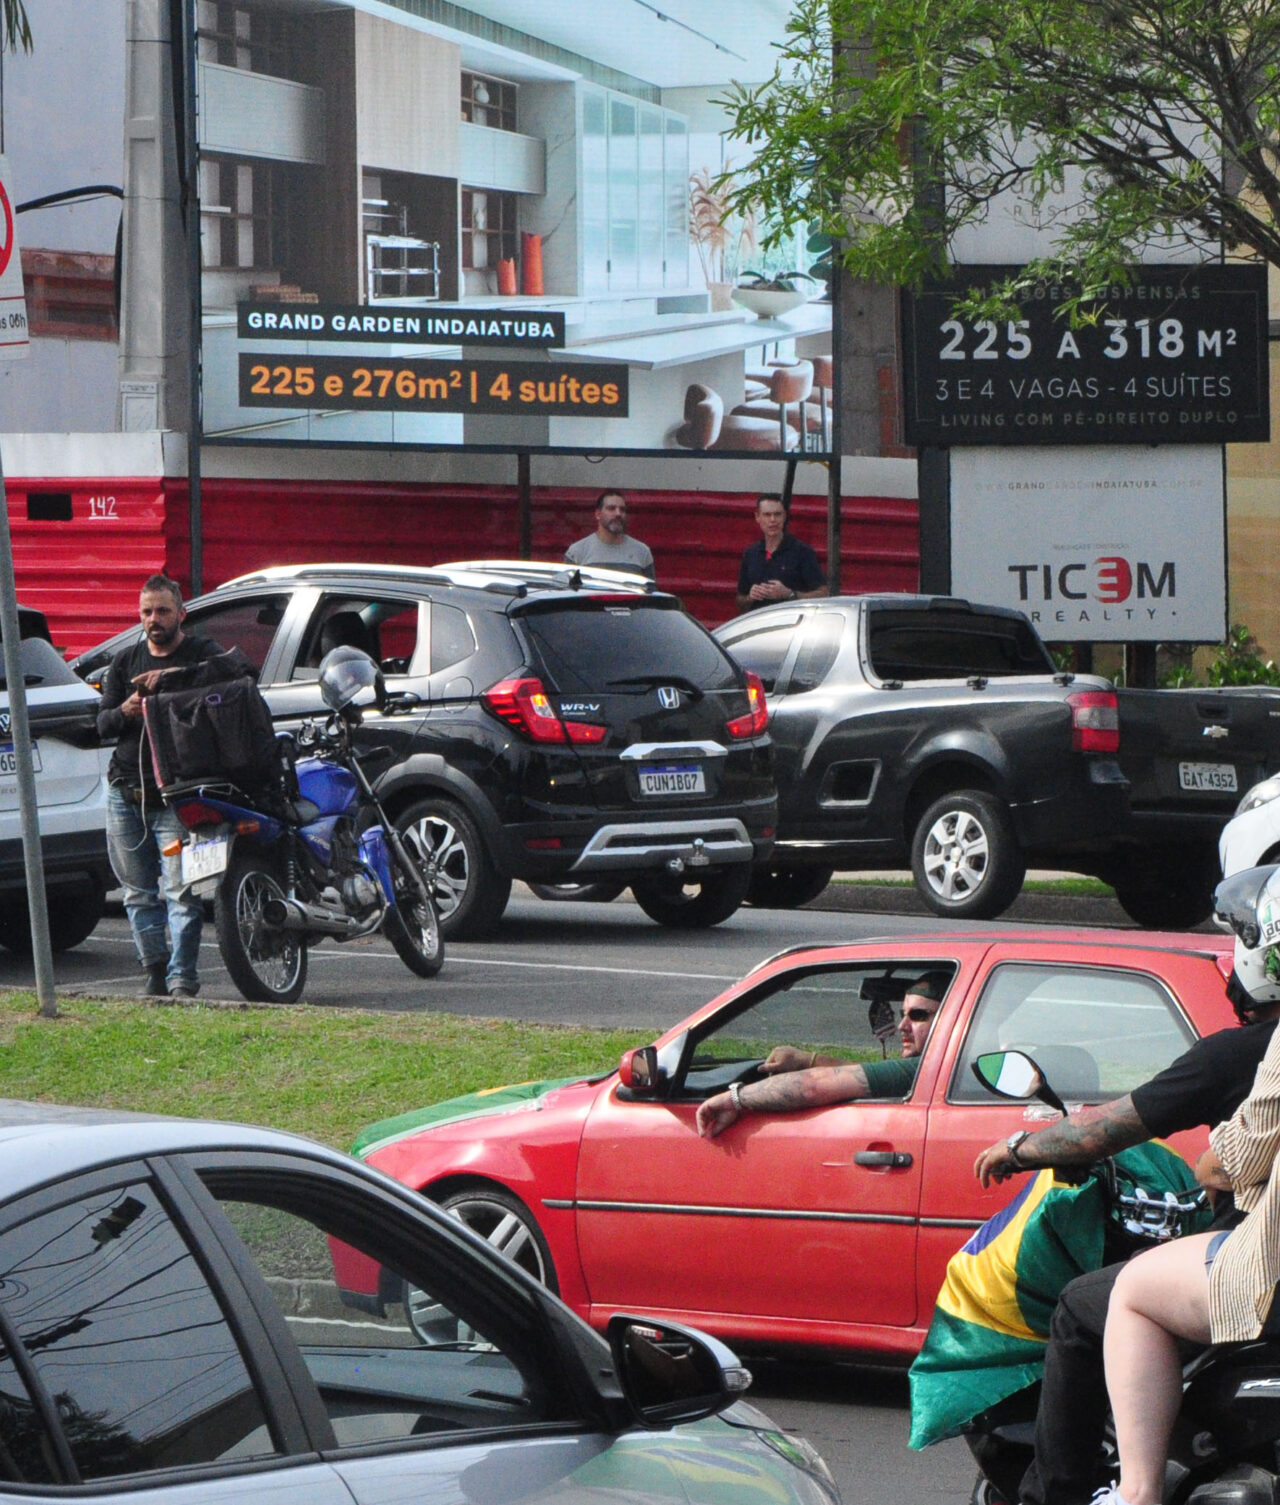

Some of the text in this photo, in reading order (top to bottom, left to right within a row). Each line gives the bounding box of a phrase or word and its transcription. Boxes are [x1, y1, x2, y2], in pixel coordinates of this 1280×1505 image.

[1082, 284, 1201, 300] USPENSAS
[248, 311, 556, 338] GRAND GARDEN INDAIATUBA
[939, 318, 1237, 360] 225 A 318 M²
[249, 365, 315, 395] 225
[324, 377, 344, 397] e
[351, 368, 461, 399] 276m²
[489, 374, 512, 401] 4
[518, 374, 619, 405] suítes
[1009, 377, 1099, 398] VAGAS
[1124, 378, 1137, 397] 4
[1146, 372, 1231, 397] SUÍTES
[941, 414, 1005, 427] LIVING
[1015, 412, 1053, 425] COM
[1179, 411, 1238, 424] DUPLO
[89, 497, 118, 515] 142
[1031, 608, 1157, 622] REALTY
[560, 703, 600, 711] WR-V
[1183, 771, 1234, 788] GAT-4352
